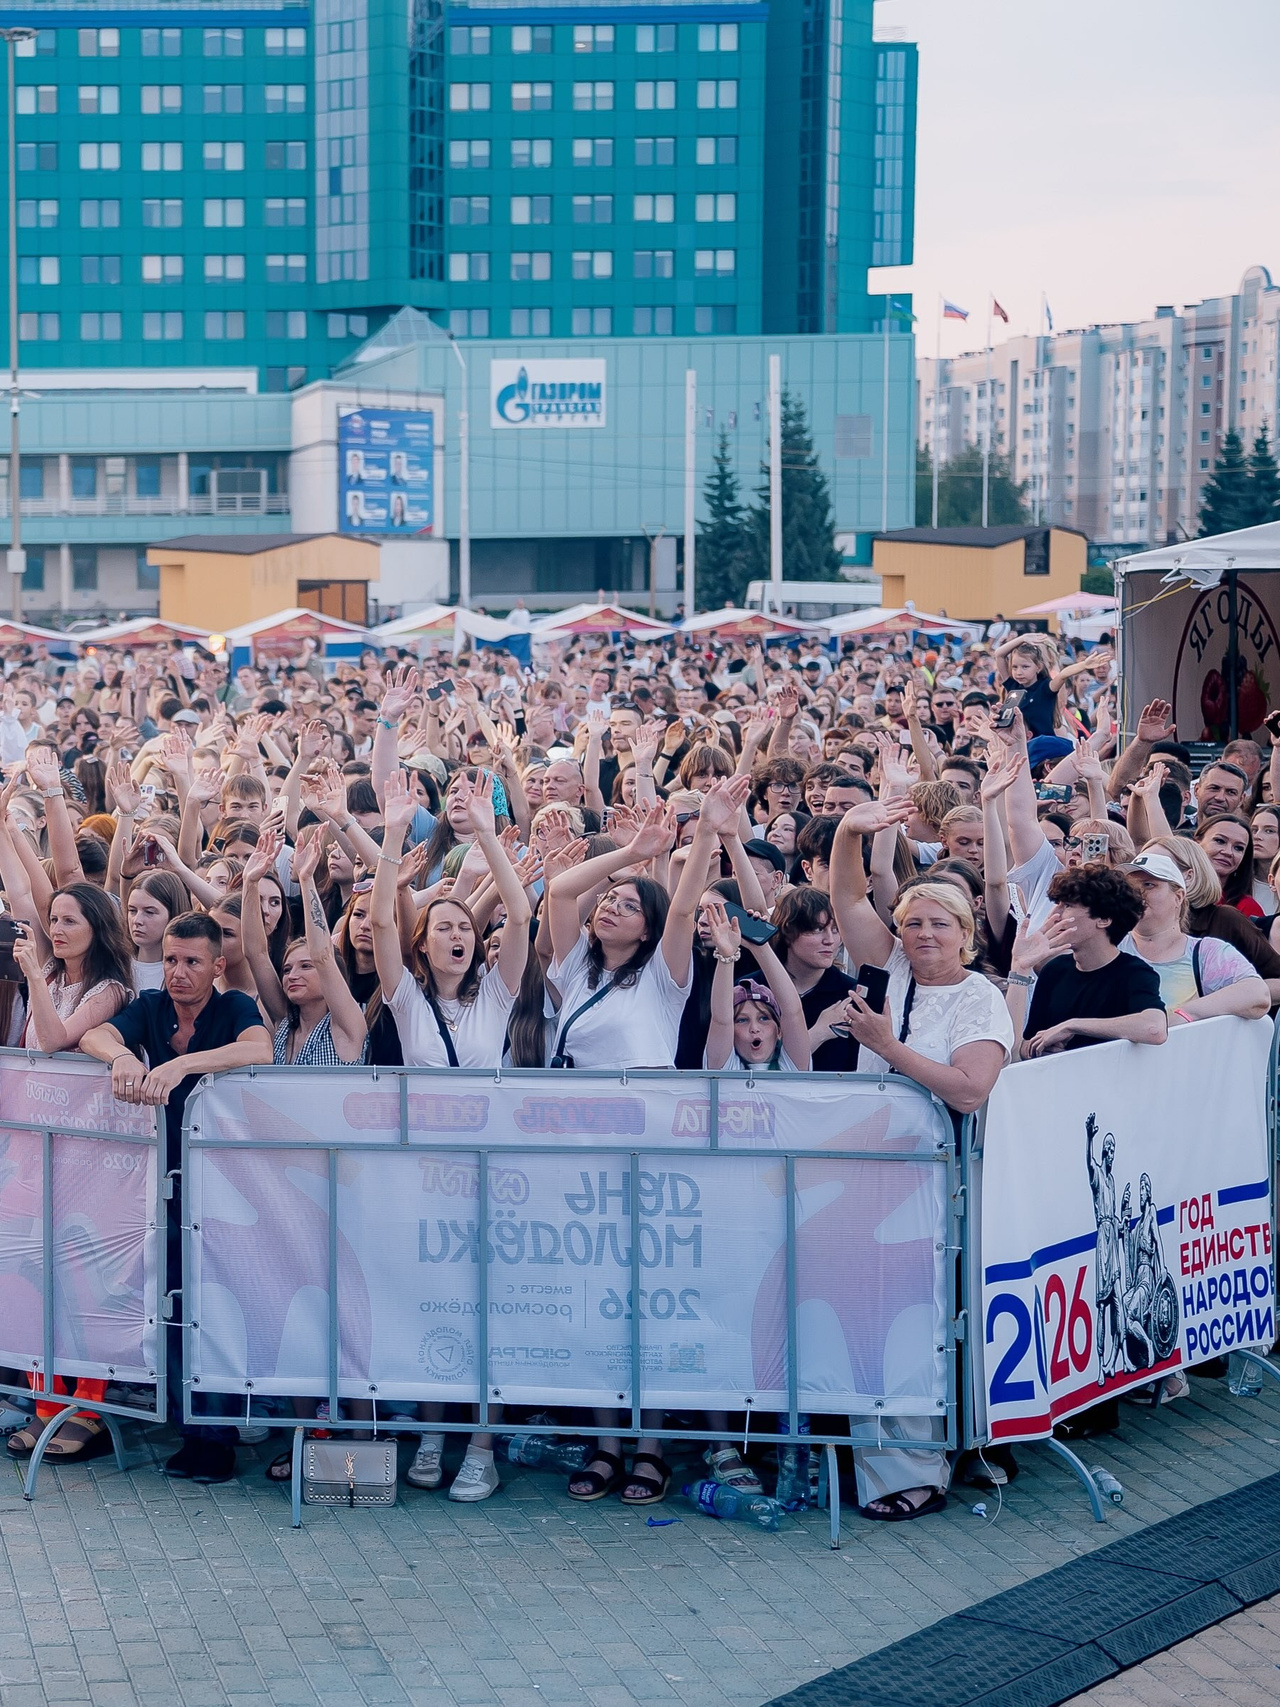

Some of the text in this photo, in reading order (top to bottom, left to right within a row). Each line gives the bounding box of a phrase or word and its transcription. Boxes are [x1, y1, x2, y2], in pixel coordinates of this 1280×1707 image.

[1189, 590, 1274, 663] ЯГОДЫ
[1179, 1193, 1214, 1234] ГОД
[1186, 1306, 1274, 1361] РОССИИ
